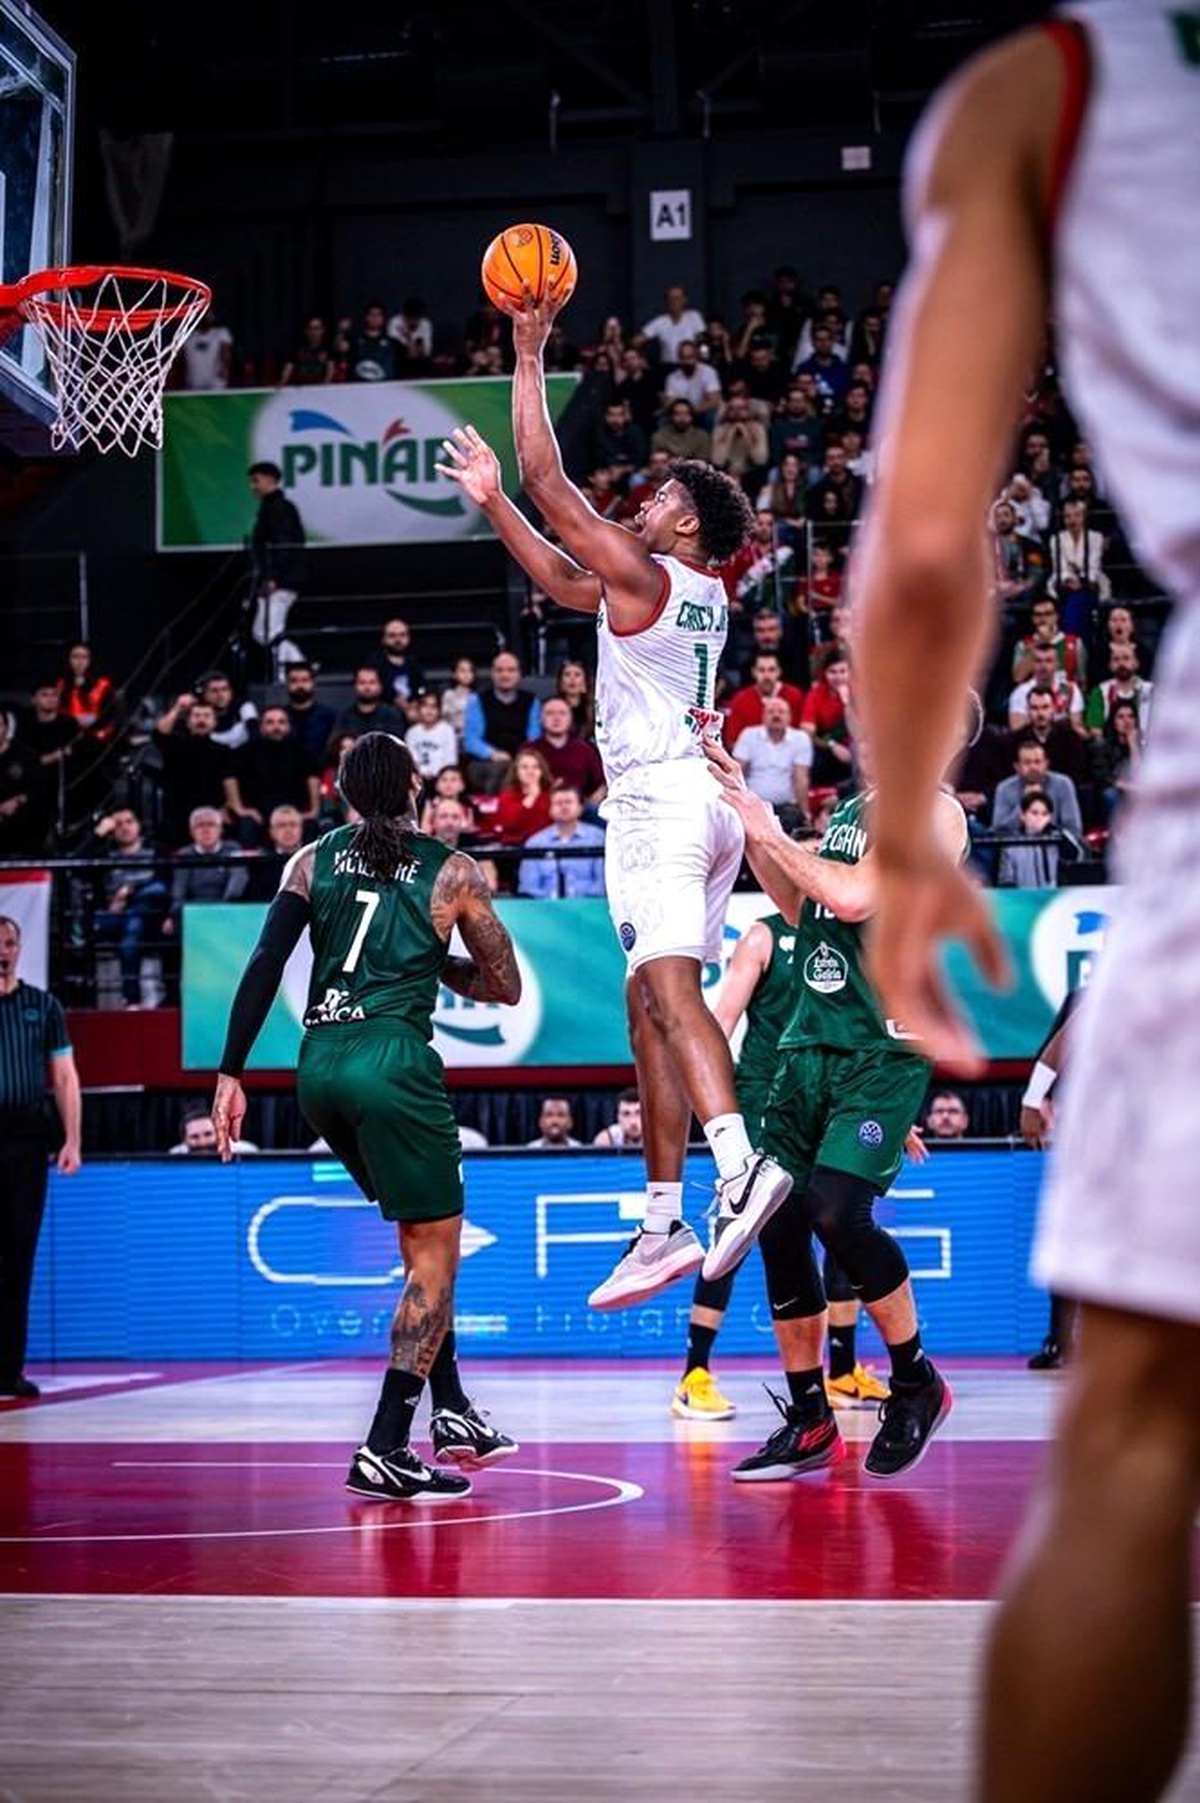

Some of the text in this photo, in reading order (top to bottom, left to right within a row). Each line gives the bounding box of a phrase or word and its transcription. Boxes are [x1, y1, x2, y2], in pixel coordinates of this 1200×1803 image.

[656, 203, 686, 228] A1
[693, 643, 708, 709] 1
[342, 889, 380, 973] 7
